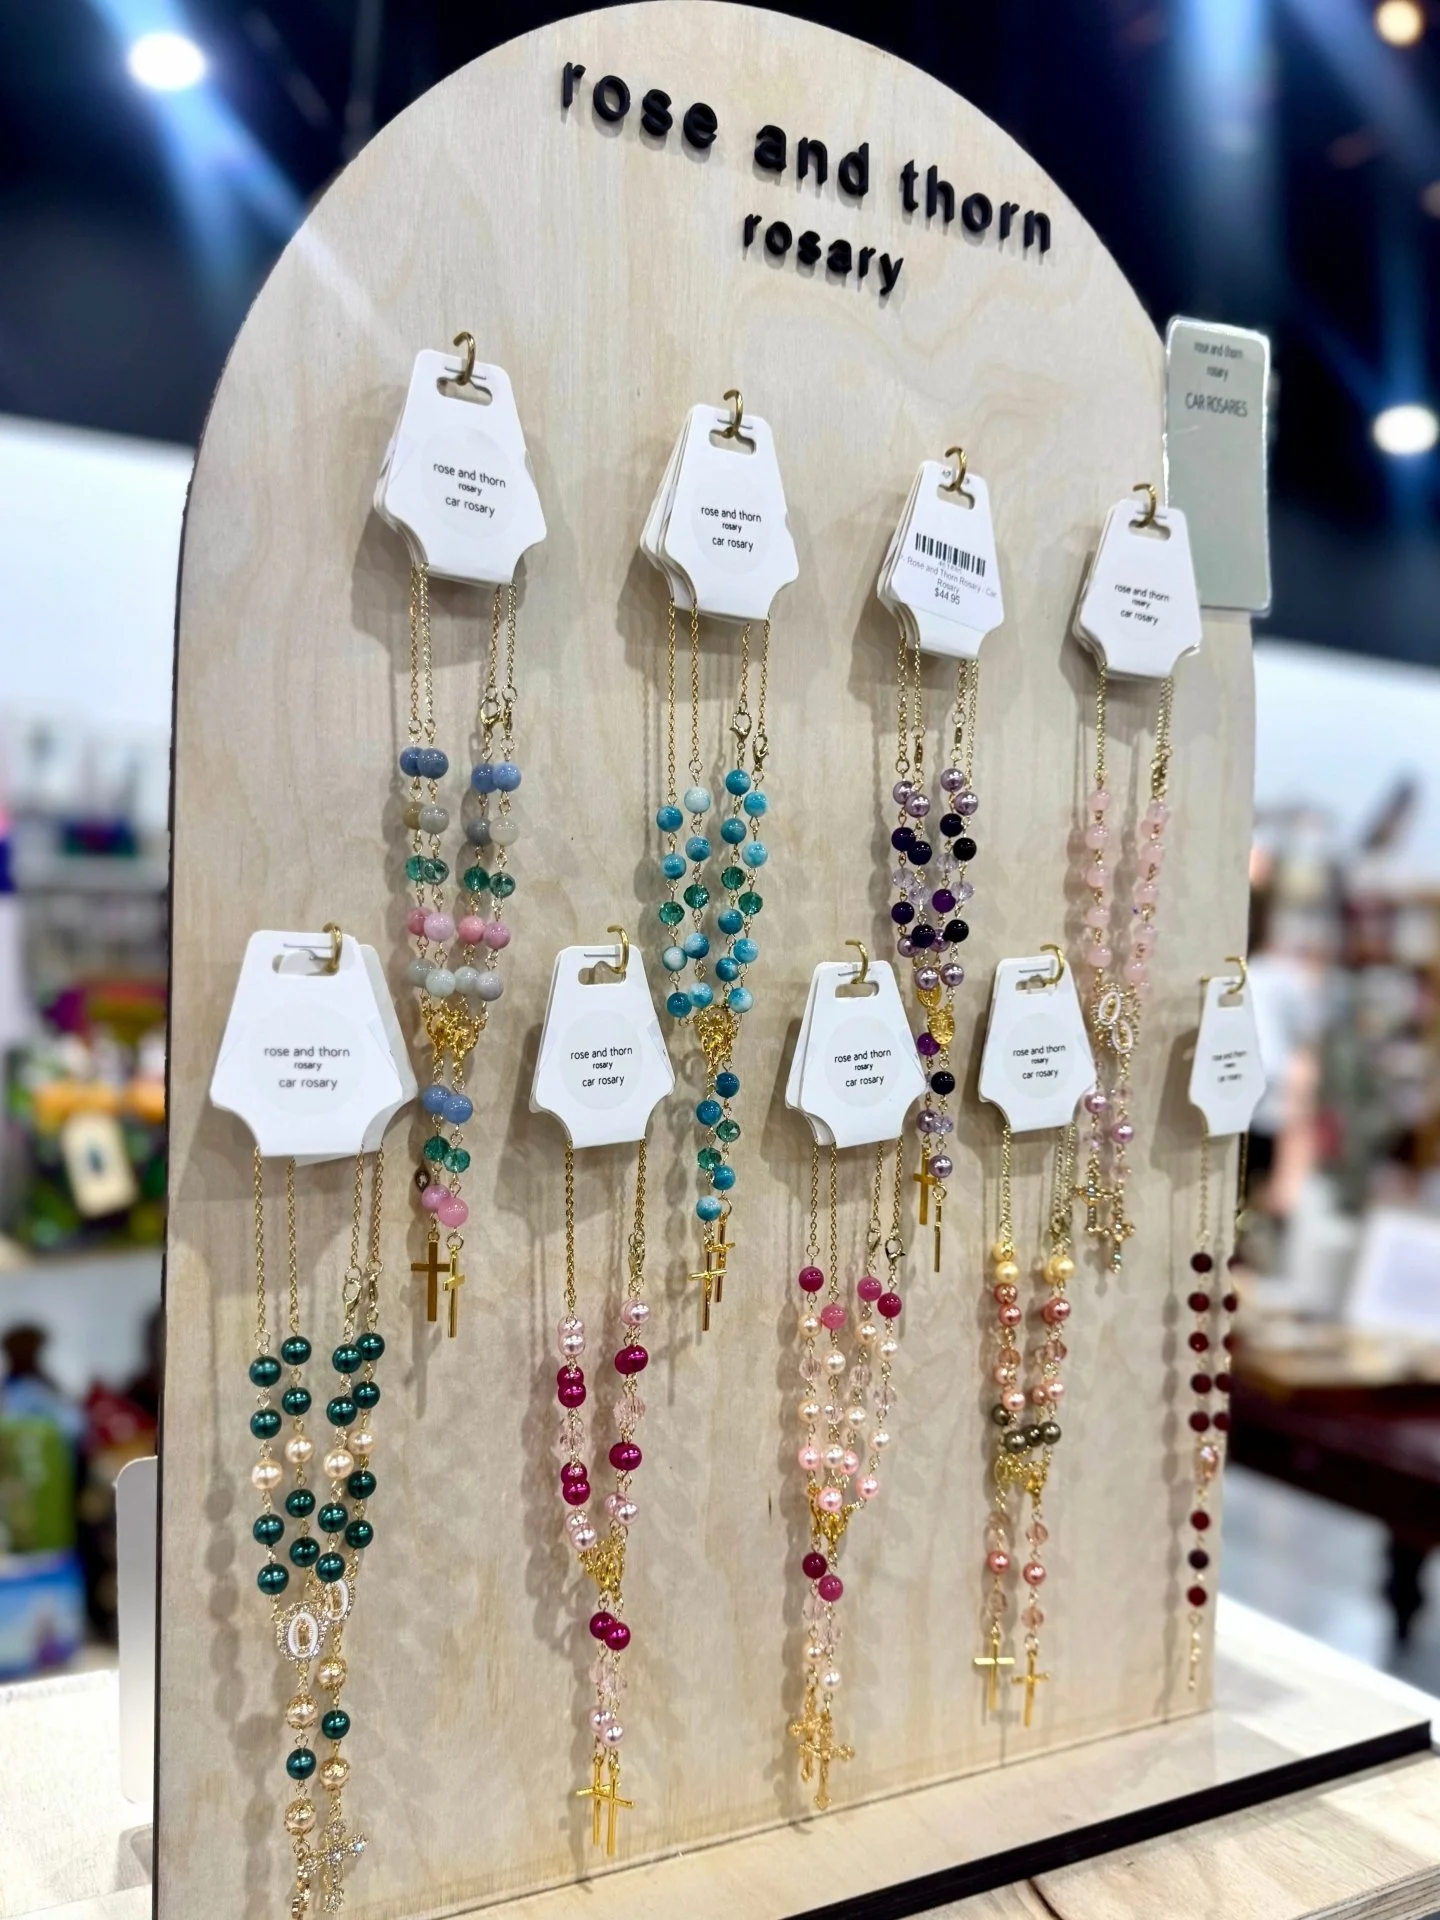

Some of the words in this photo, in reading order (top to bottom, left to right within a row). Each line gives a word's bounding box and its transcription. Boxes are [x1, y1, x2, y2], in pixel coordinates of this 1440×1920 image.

[562, 61, 718, 149] rose
[754, 124, 869, 197] and
[901, 159, 1051, 253] thorn
[744, 213, 903, 295] rosary
[433, 463, 455, 476] rose
[458, 469, 476, 481] and
[480, 472, 506, 488] thorn
[458, 483, 482, 496] rosary
[445, 496, 460, 507] car
[464, 501, 495, 519] rosary
[701, 507, 719, 517] rose
[721, 508, 736, 519] and
[739, 510, 761, 522] thorn
[722, 522, 742, 533] rosary
[712, 537, 724, 546] car
[728, 539, 753, 552] rosary
[940, 567, 958, 582] Thorn
[938, 578, 960, 593] Rosary
[1115, 584, 1131, 594] rose
[1133, 588, 1147, 598] and
[1149, 590, 1170, 602] thorn
[1120, 610, 1132, 618] car
[1134, 612, 1158, 626] rosary
[264, 1047, 290, 1057] rose
[293, 1046, 315, 1057] and
[318, 1046, 350, 1057] thorn
[570, 1051, 590, 1060] rose
[591, 1047, 608, 1058] and
[610, 1046, 633, 1057] thorn
[834, 1054, 852, 1063] rose
[853, 1050, 868, 1061] and
[870, 1049, 892, 1059] thorn
[1013, 1048, 1029, 1056] rose
[1030, 1045, 1044, 1055] and
[1046, 1044, 1066, 1053] thorn
[294, 1062, 322, 1072] rosary
[592, 1061, 613, 1070] rosary
[854, 1063, 873, 1071] rosary
[582, 1078, 595, 1087] car
[598, 1075, 625, 1087] rosary
[845, 1079, 857, 1087] car
[860, 1075, 884, 1085] rosary
[1022, 1071, 1033, 1080] car
[1036, 1069, 1059, 1078] rosary
[278, 1079, 296, 1088] car
[301, 1079, 338, 1091] rosary
